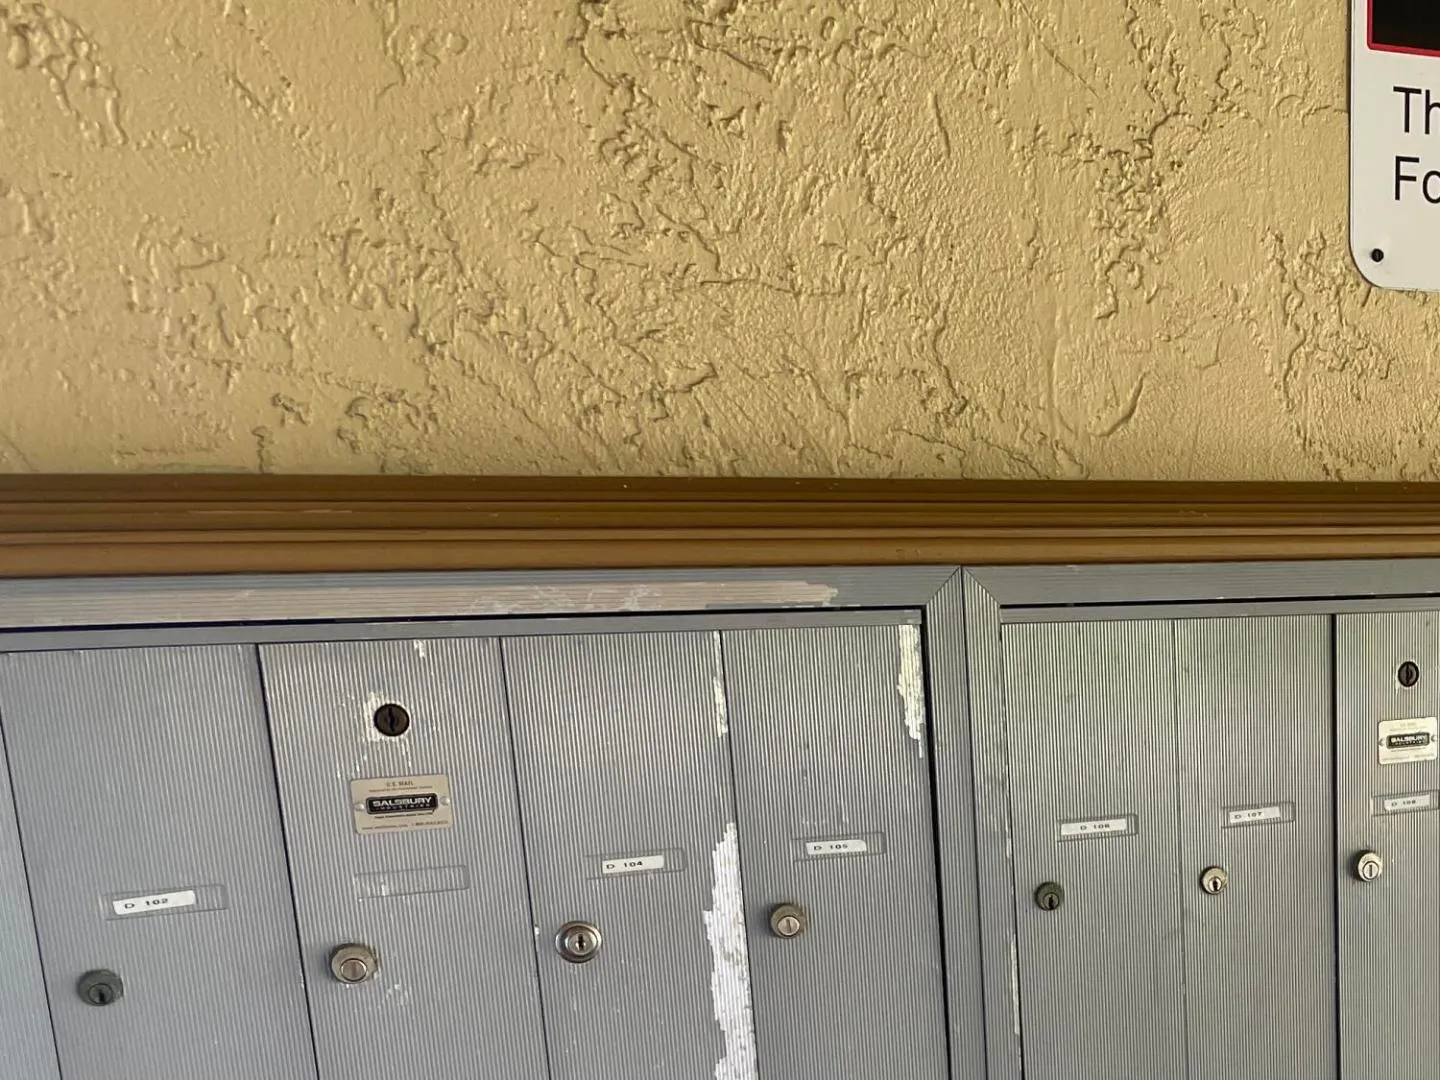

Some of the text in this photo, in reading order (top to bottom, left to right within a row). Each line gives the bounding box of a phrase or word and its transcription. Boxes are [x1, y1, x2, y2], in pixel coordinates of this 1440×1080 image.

[373, 796, 432, 807] SALSBURY
[623, 860, 643, 868] 104
[124, 897, 169, 910] D 102
